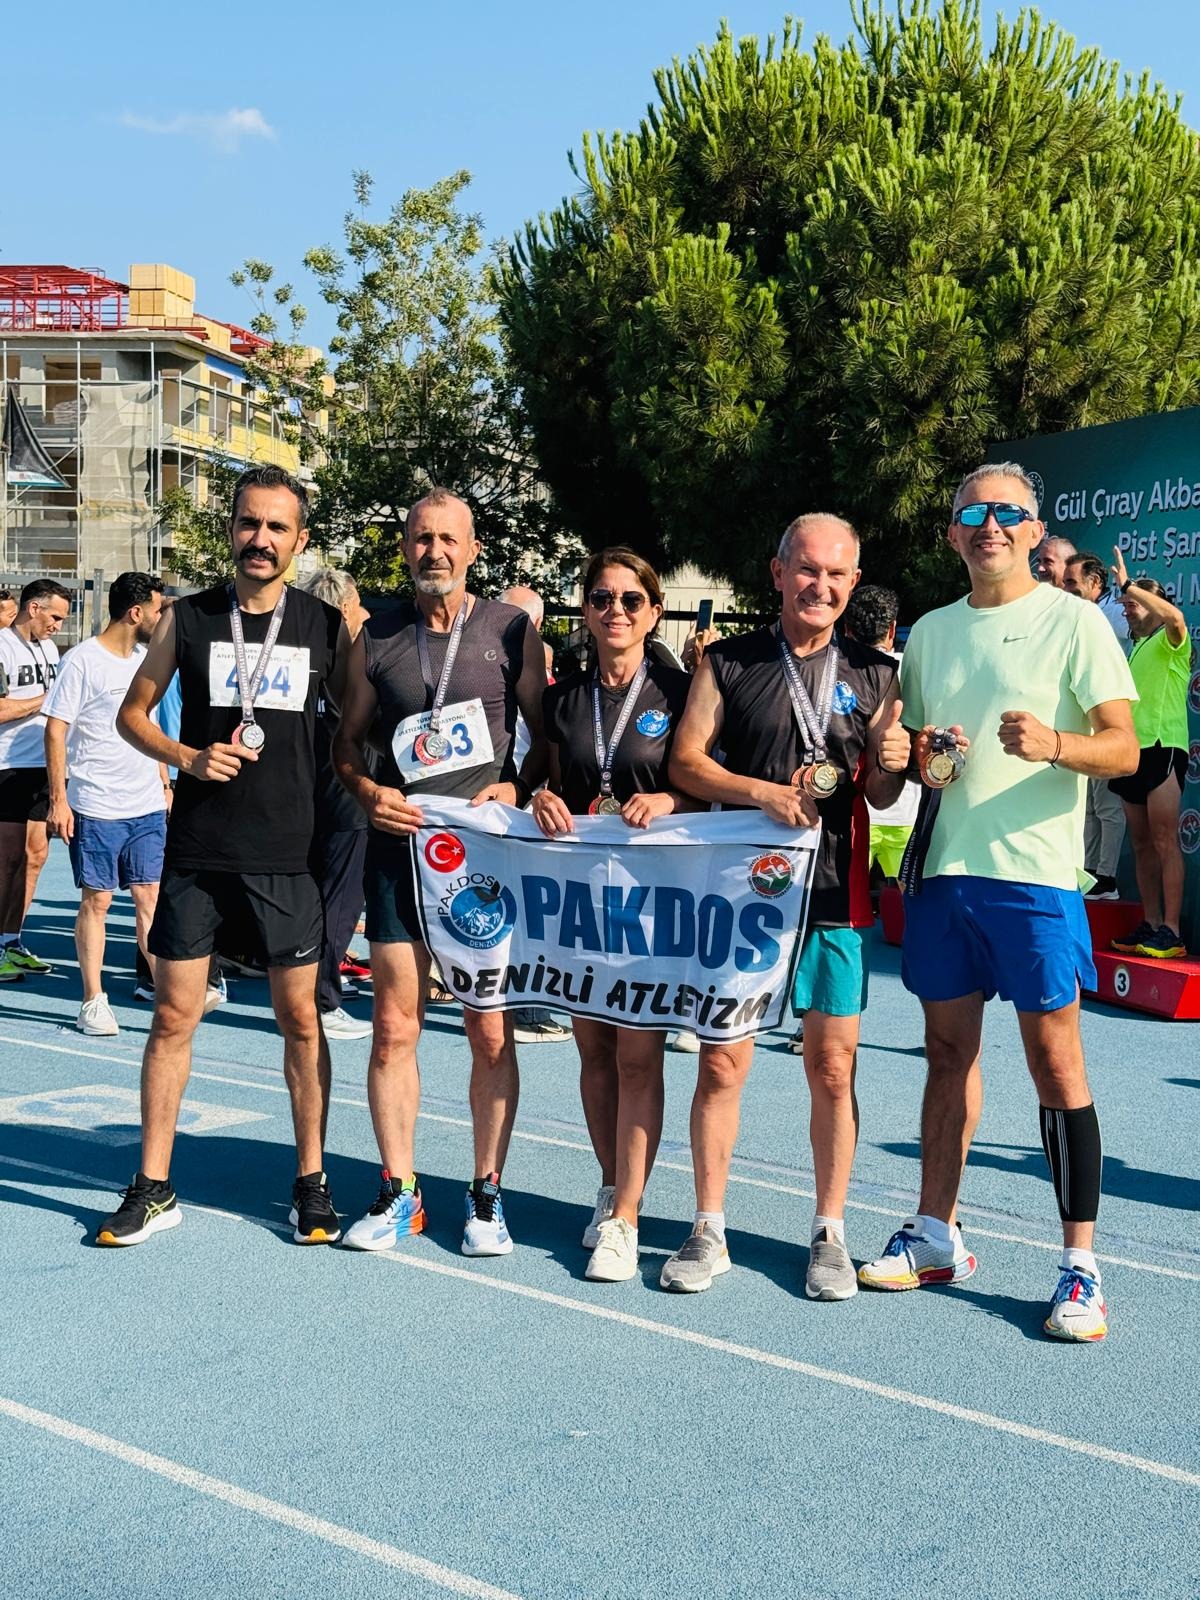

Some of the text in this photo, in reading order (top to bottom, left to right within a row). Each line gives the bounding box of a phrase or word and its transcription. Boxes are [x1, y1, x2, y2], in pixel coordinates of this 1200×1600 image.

[1055, 477, 1200, 525] Gül Çıray Akba
[1118, 529, 1157, 562] Pist
[17, 663, 58, 687] BEA
[437, 873, 496, 916] PAKDOS
[521, 875, 784, 973] PAKDOS
[1117, 972, 1127, 992] 3
